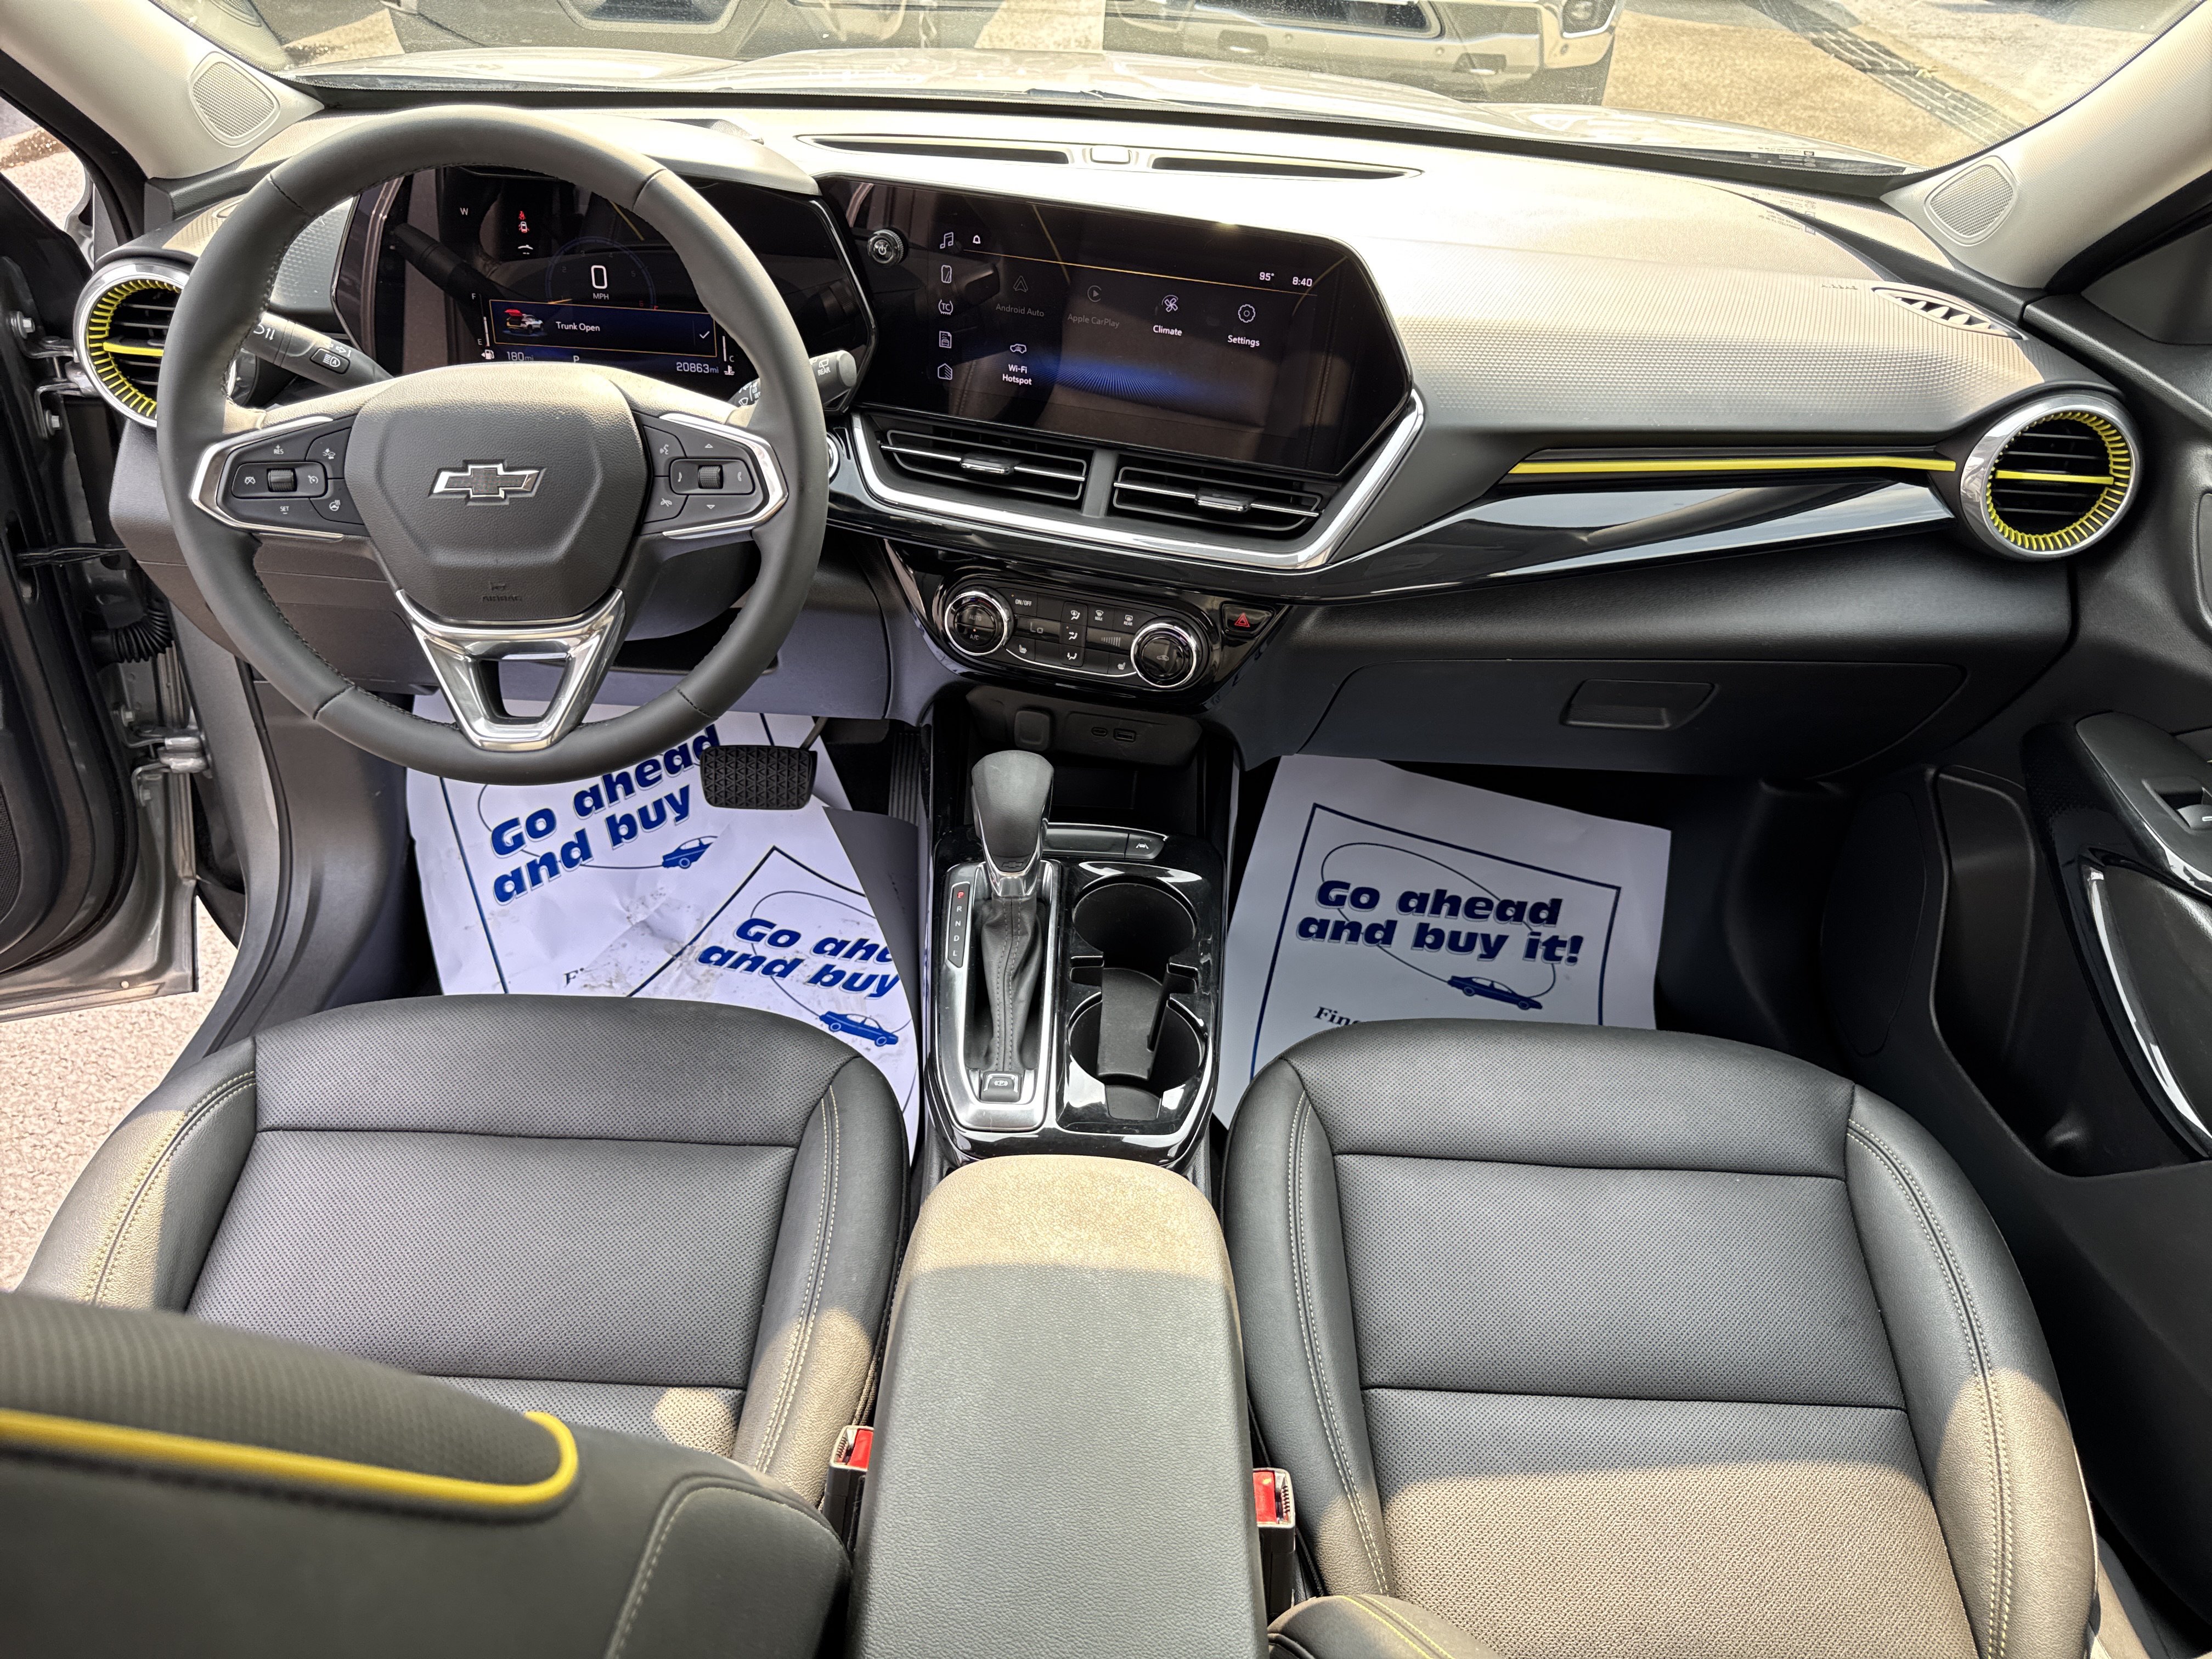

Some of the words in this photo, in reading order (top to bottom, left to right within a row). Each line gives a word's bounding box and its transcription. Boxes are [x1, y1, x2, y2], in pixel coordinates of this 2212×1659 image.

[460, 207, 469, 216] W
[591, 265, 608, 289] 0
[1259, 272, 1275, 281] 95°
[1292, 276, 1313, 287] 8:40
[995, 303, 1025, 315] Android
[1026, 307, 1045, 317] Auto
[556, 321, 578, 330] Trunk
[579, 322, 601, 332] Open
[1068, 313, 1090, 324] Apple
[1091, 316, 1120, 329] CarPlay
[1153, 324, 1183, 336] Climate
[1227, 335, 1260, 348] Settings
[573, 355, 580, 363] P
[817, 367, 831, 376] REAR
[1008, 364, 1028, 374] Wi-Fi
[1002, 374, 1032, 386] Hotspot
[490, 808, 557, 859] Go
[573, 724, 720, 820] ahead
[493, 827, 594, 906] and
[604, 785, 690, 850] buy
[1316, 879, 1380, 912] Go
[1395, 888, 1563, 928] ahead
[733, 917, 802, 950] Go
[1296, 916, 1398, 948] and
[1410, 922, 1509, 962] buy
[1521, 931, 1584, 966] it!
[696, 945, 805, 980] and
[802, 963, 901, 1001] buy
[1313, 1006, 1361, 1026] Fin
